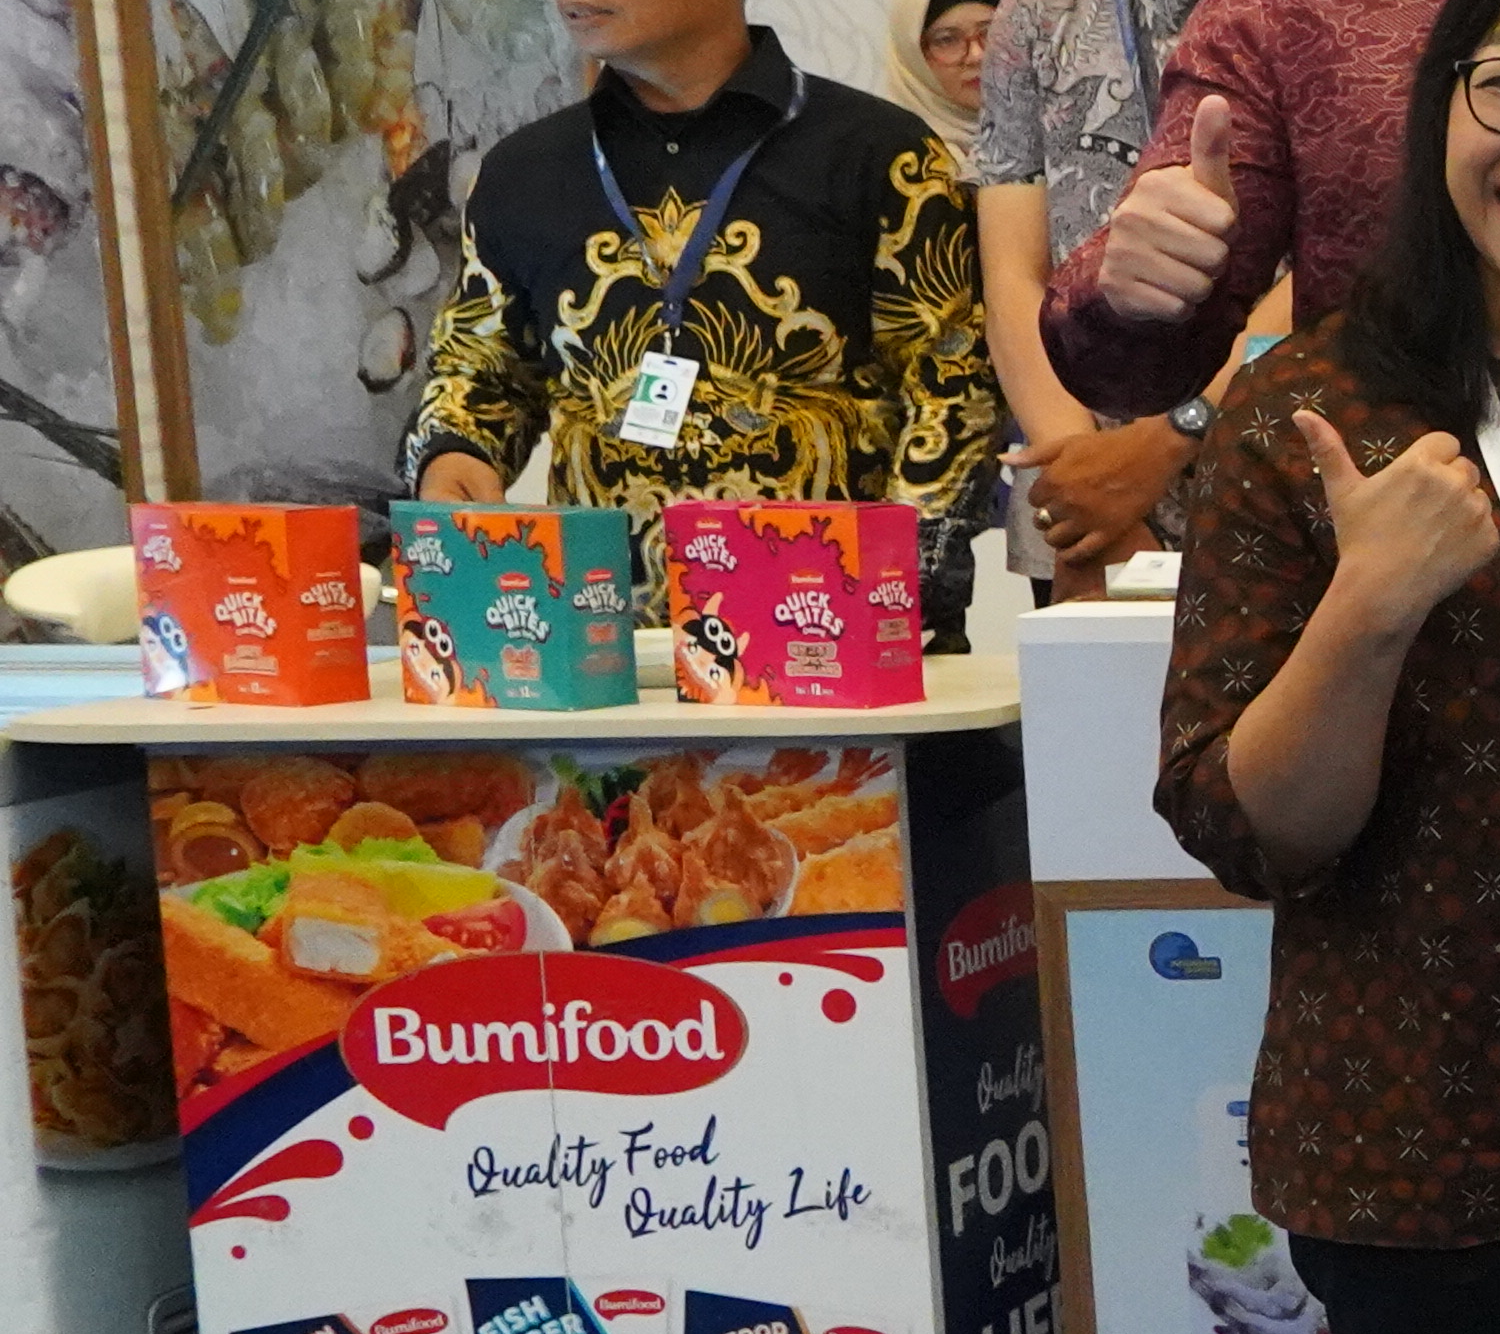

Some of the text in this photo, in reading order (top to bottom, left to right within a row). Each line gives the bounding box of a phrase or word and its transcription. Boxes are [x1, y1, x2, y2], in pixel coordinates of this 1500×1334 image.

[407, 537, 443, 561] QUICK
[685, 534, 727, 560] QUICK
[700, 545, 738, 571] BITES
[418, 549, 452, 575] BITES
[300, 581, 347, 604] QUICK
[319, 591, 356, 609] BITES
[573, 582, 616, 607] QUICK
[590, 593, 627, 613] BITES
[868, 580, 906, 605] QUICK
[882, 590, 915, 610] BITES
[214, 592, 264, 622] QUICK
[486, 594, 538, 624] QUICK
[774, 590, 831, 622] QUICK
[232, 608, 278, 638] BITES
[504, 608, 550, 643] BITES
[796, 607, 844, 638] BITES
[373, 999, 725, 1065] Bumifood
[467, 1113, 720, 1209] Quality Food
[625, 1167, 871, 1249] Quality Life
[600, 1298, 661, 1311] Bumifood
